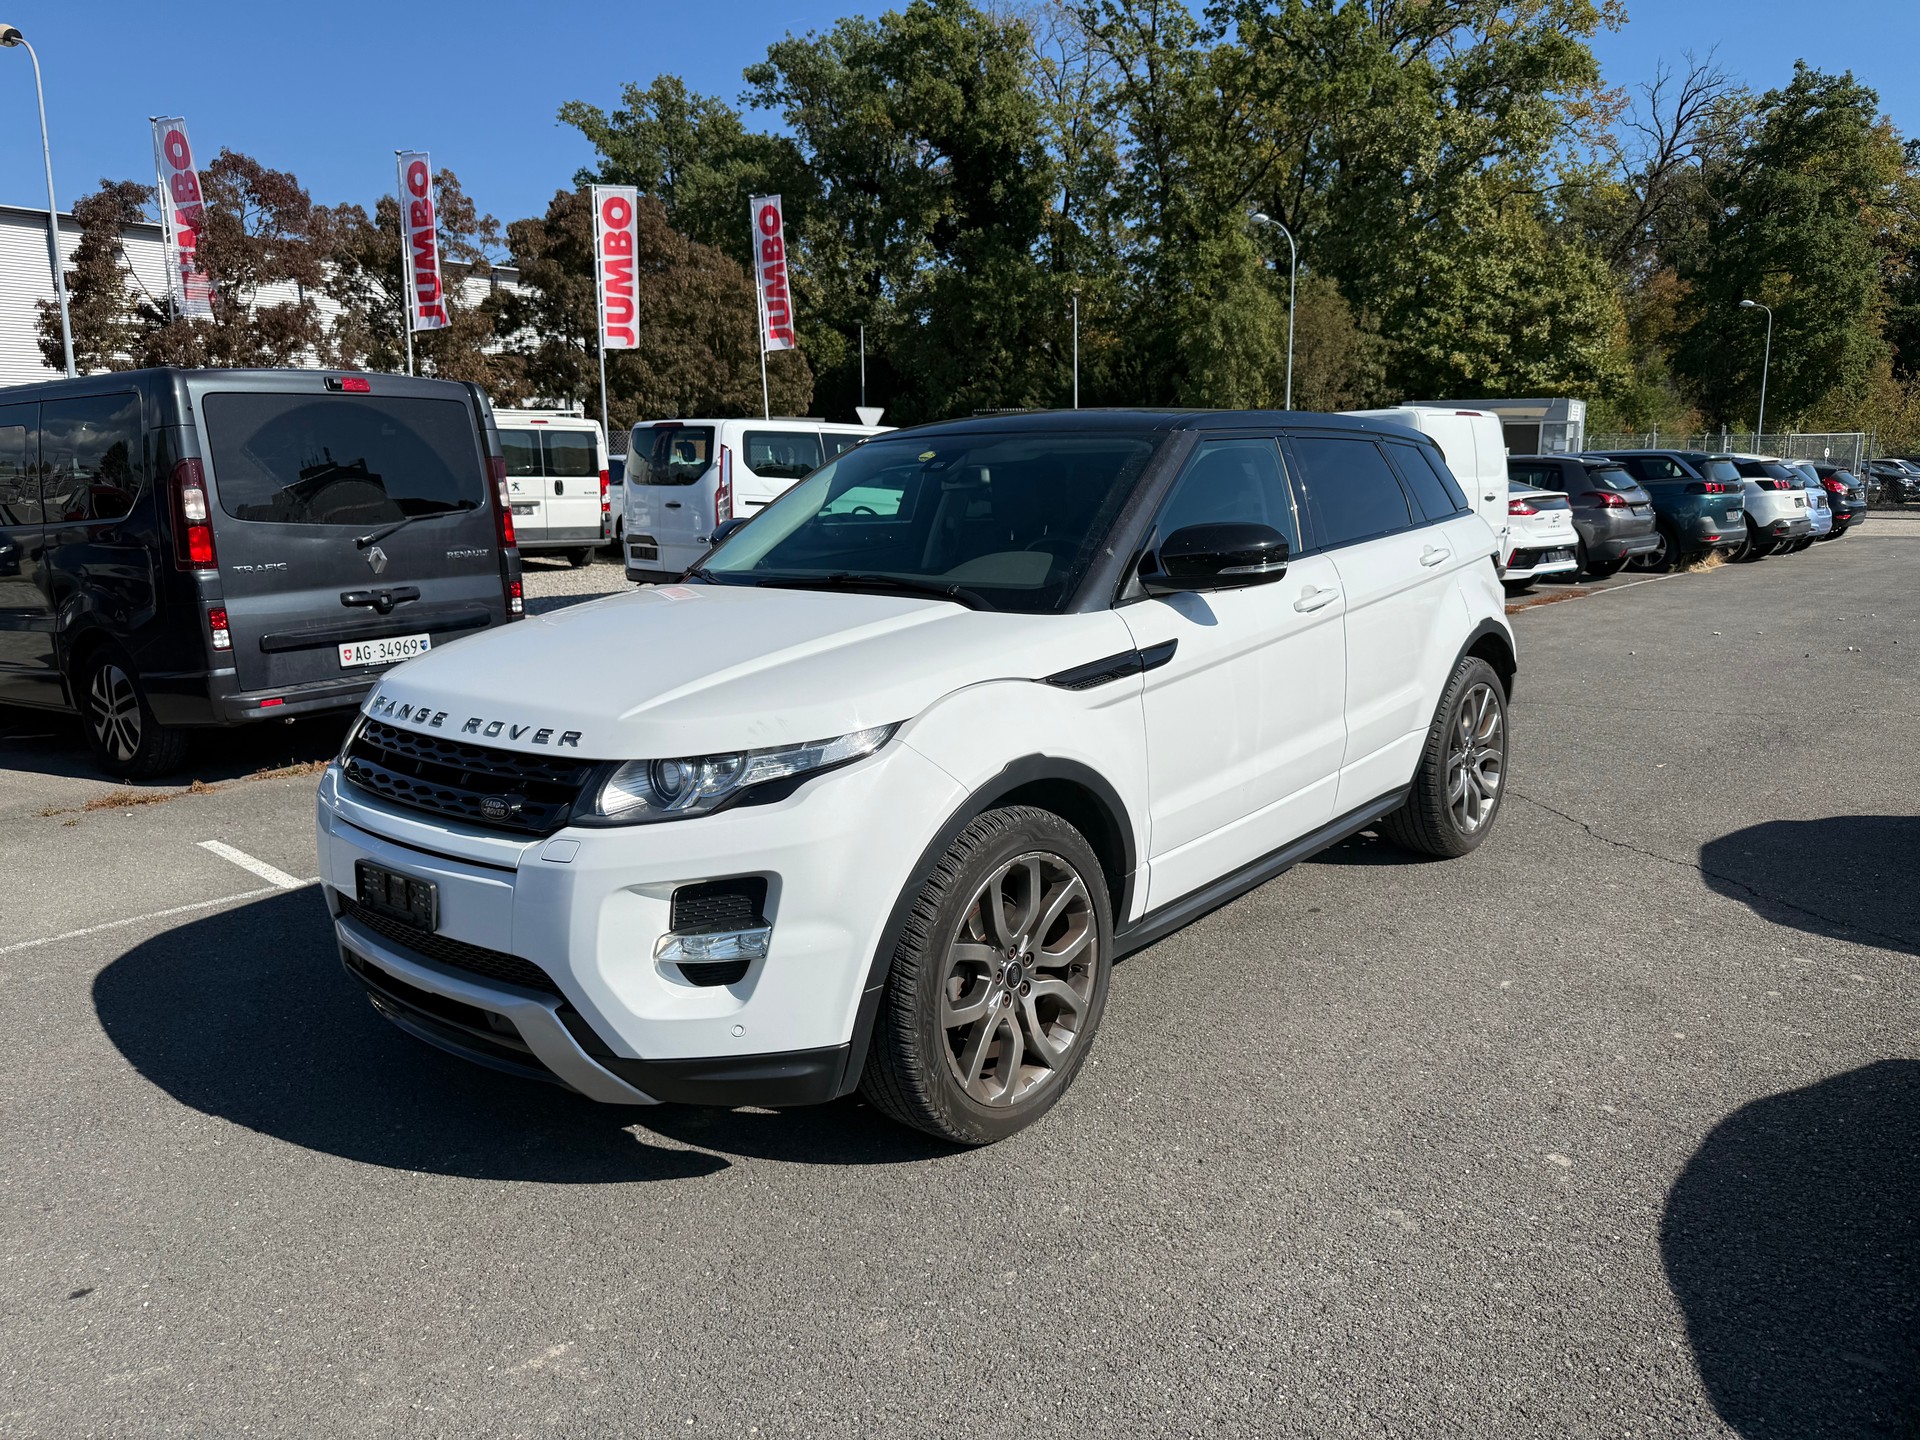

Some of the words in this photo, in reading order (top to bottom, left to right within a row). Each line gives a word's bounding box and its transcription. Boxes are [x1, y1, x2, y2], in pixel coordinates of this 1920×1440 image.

[407, 160, 447, 325] JUMBO
[602, 196, 635, 346] JUMBO
[759, 205, 795, 347] JUMBO
[232, 562, 287, 575] TRAFIC
[446, 548, 490, 559] RENAULT
[373, 695, 449, 728] RANGE
[461, 717, 583, 747] ROVER
[485, 800, 501, 808] LAND
[486, 807, 506, 816] ROVER
